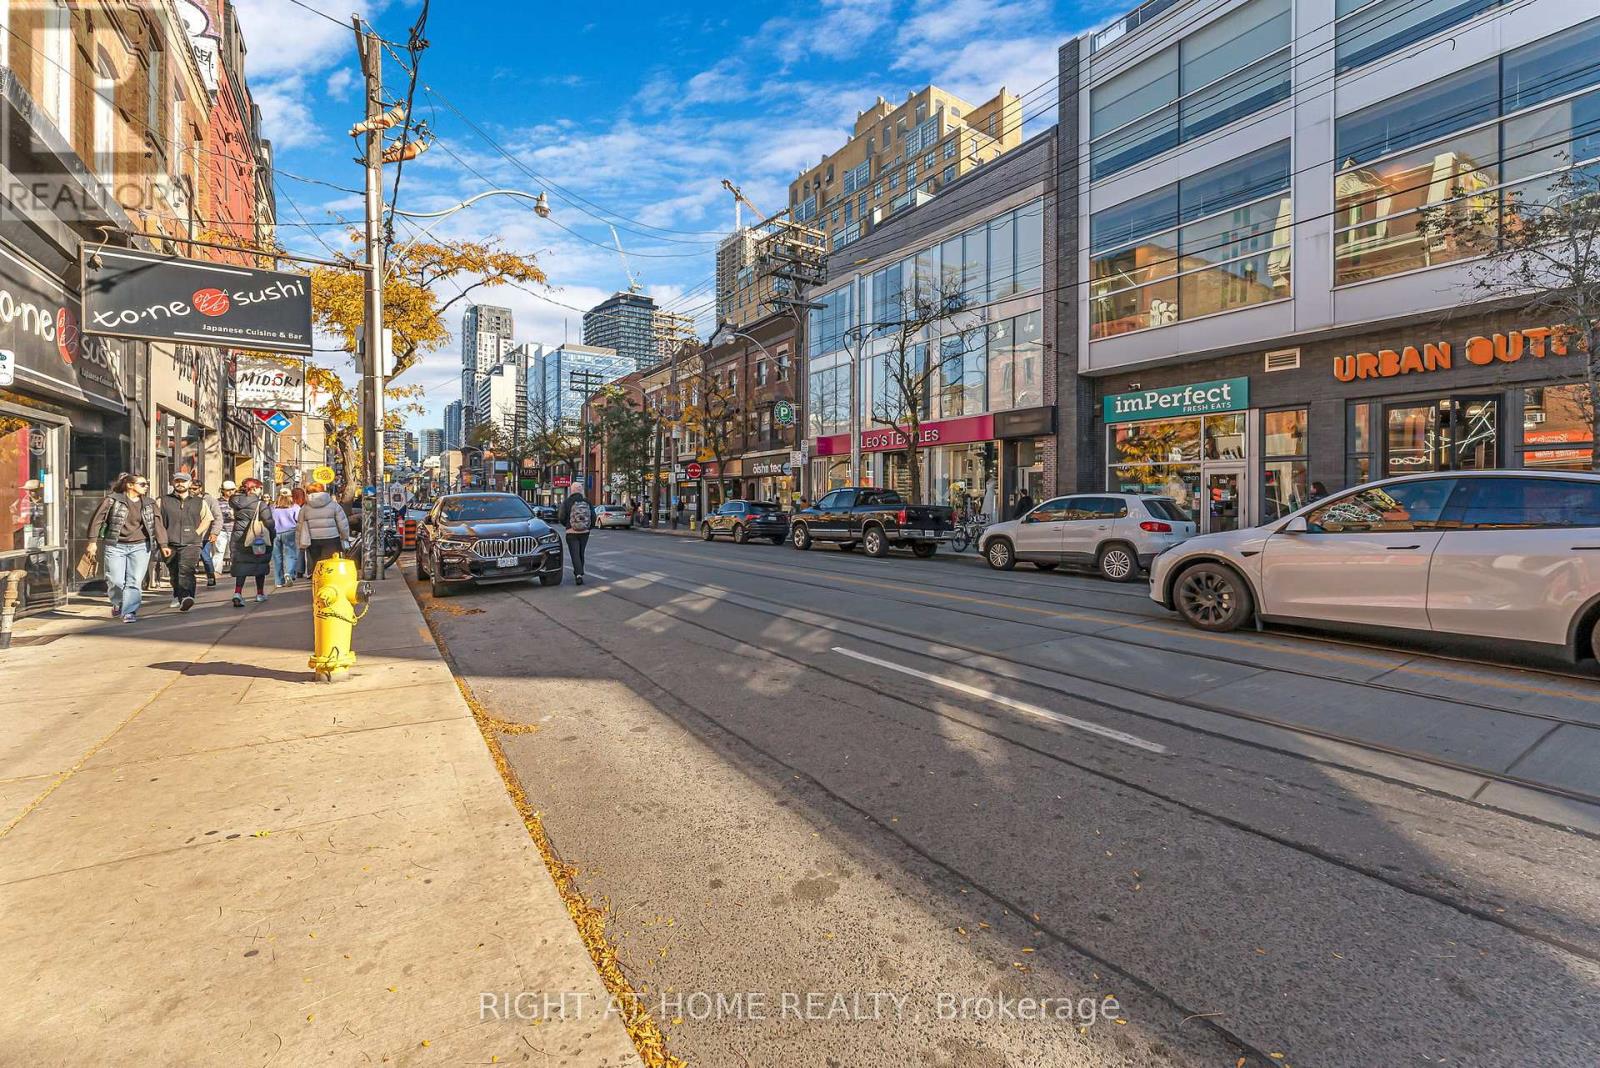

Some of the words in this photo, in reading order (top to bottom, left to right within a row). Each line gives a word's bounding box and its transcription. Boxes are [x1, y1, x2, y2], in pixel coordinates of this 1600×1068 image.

[233, 279, 304, 305] sushi
[202, 323, 244, 336] Japanese
[246, 328, 277, 338] Cuisine
[279, 331, 286, 339] &
[288, 332, 303, 340] Bar
[1333, 341, 1451, 382] URBAN
[1115, 383, 1231, 413] imPerfect
[1183, 405, 1208, 413] FRESH
[1210, 401, 1232, 410] EATS
[781, 408, 788, 417] P
